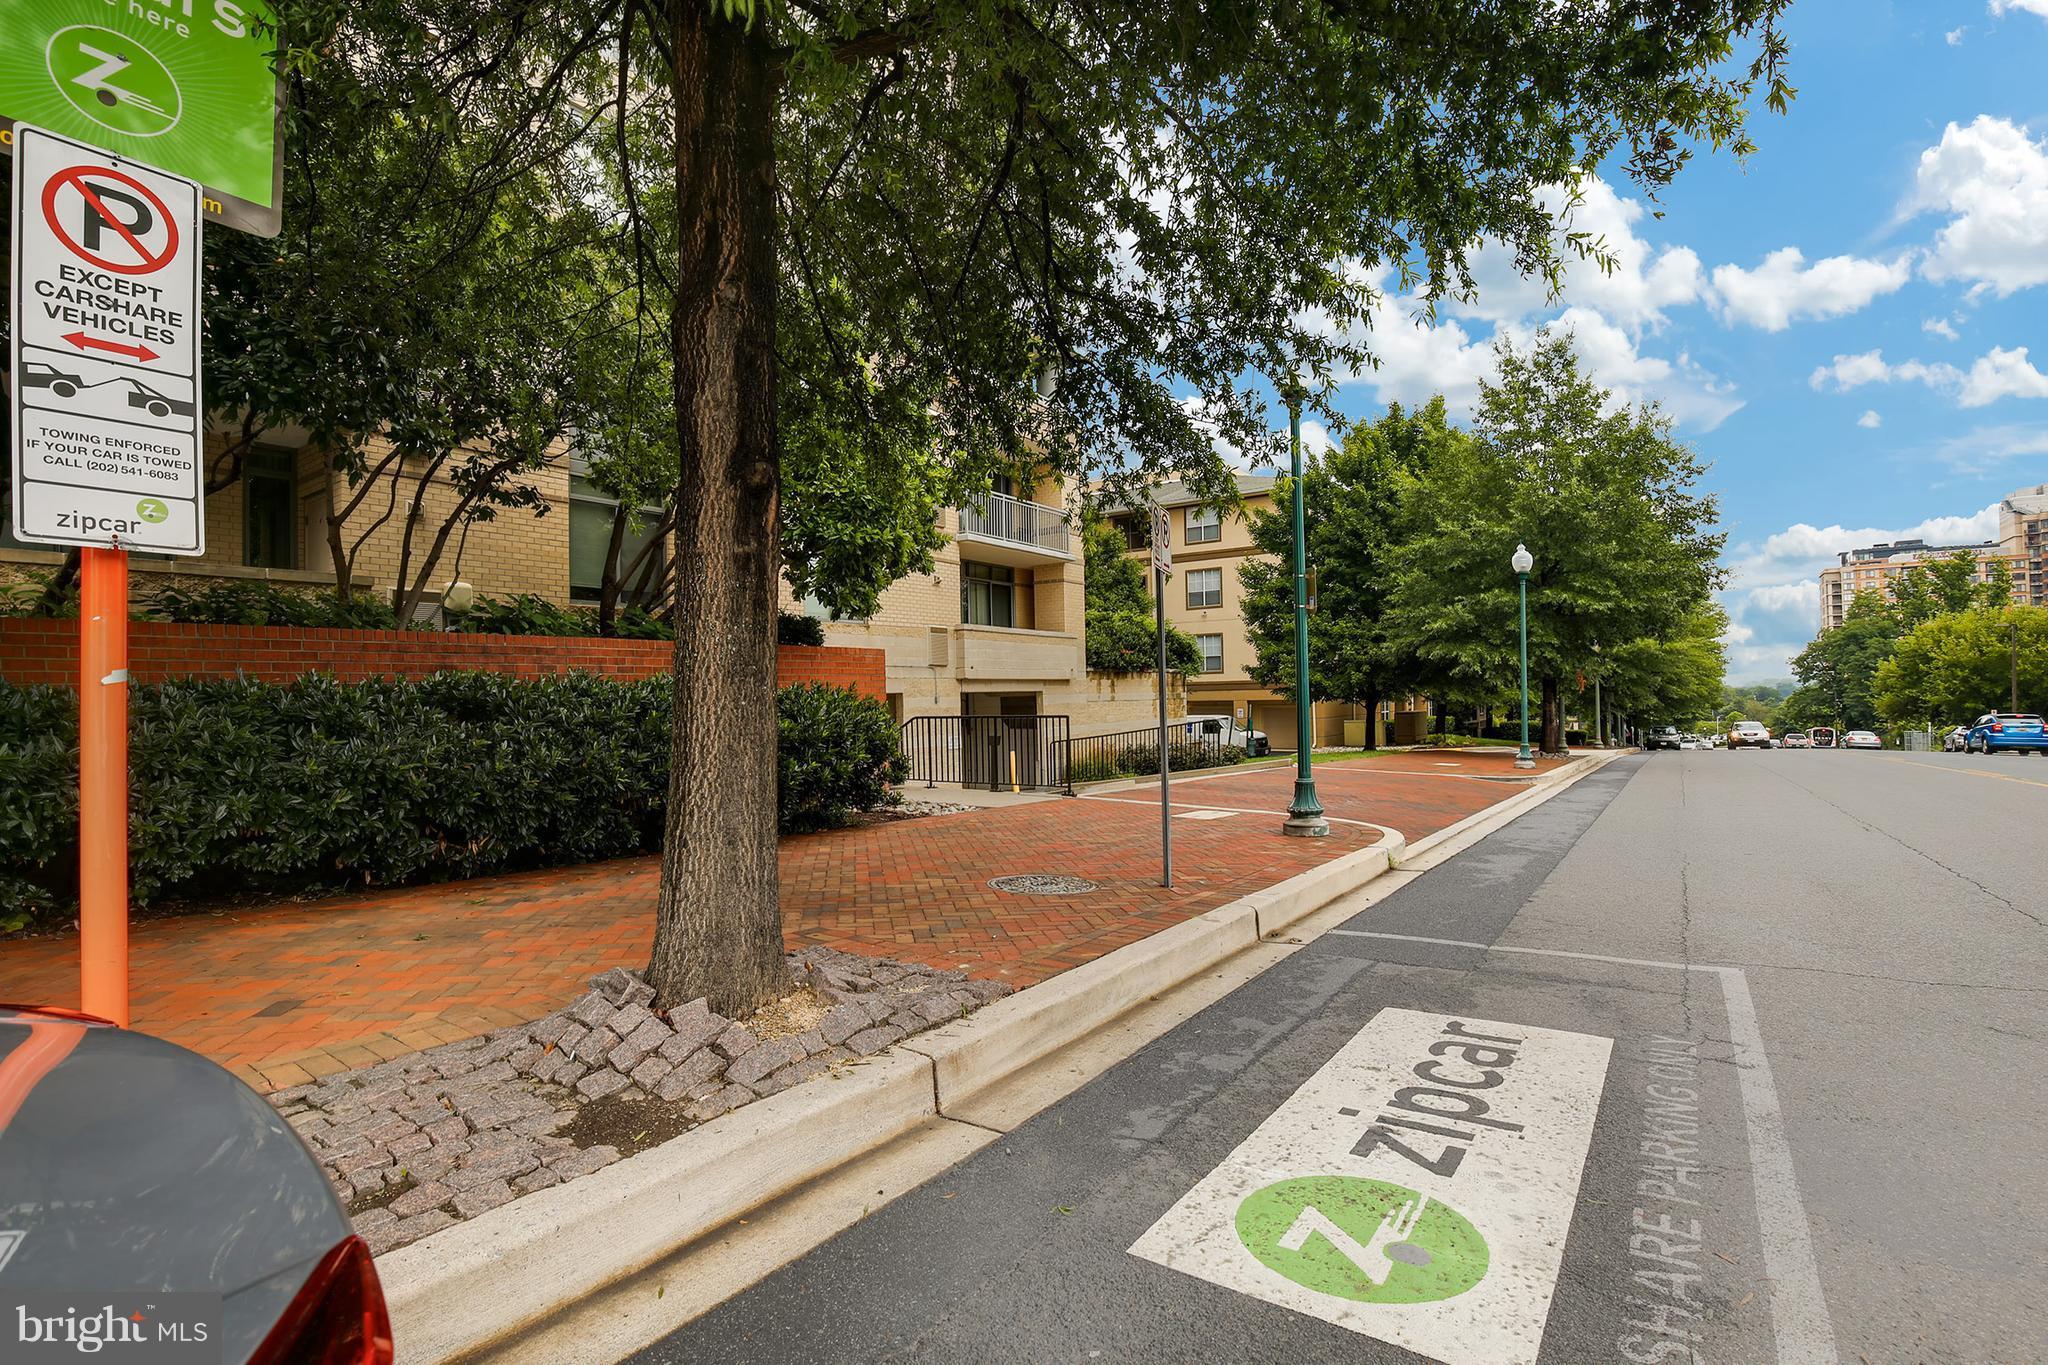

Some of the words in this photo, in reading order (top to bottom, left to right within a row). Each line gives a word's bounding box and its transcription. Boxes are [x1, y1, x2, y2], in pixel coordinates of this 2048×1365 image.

[34, 280, 183, 328] CARSHARE
[59, 263, 163, 303] EXCEPT
[43, 301, 175, 345] VEHICLES
[26, 439, 40, 449] IF
[44, 442, 88, 456] YOUR
[92, 448, 122, 461] CAR
[126, 453, 139, 463] IS
[143, 456, 192, 470] TOWED
[39, 427, 101, 444] TOWING
[105, 437, 181, 456] ENFORCED
[43, 455, 82, 468] CALL
[87, 460, 119, 474] (202)
[120, 466, 179, 481] 541-6083
[56, 510, 142, 534] zipcar
[1649, 1034, 1698, 1081] ONLY
[1338, 1020, 1525, 1178] zipcar
[1636, 1084, 1701, 1206] PARKING
